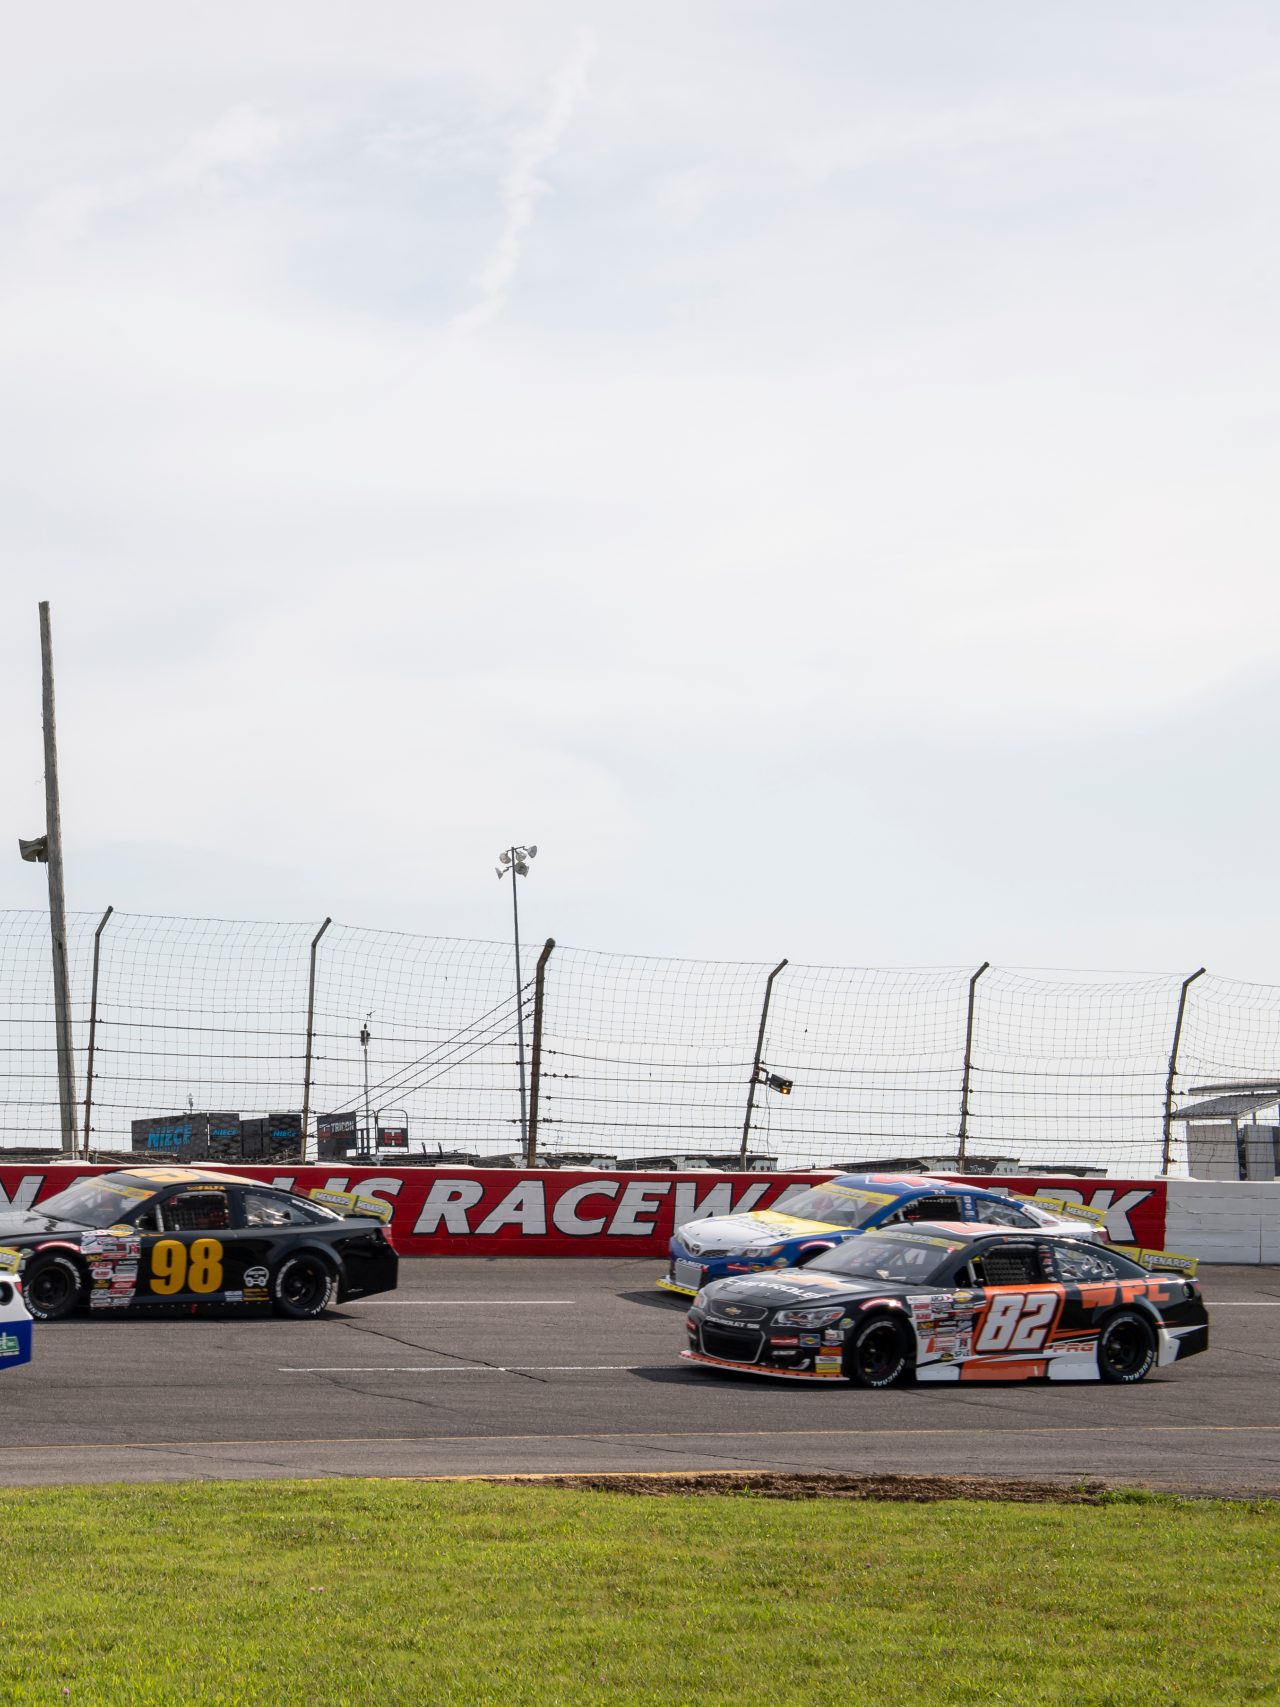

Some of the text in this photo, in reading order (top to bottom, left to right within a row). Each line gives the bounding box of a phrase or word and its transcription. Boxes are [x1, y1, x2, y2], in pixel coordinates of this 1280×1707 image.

[331, 1121, 355, 1132] TRICON
[150, 1238, 224, 1294] 98
[675, 1258, 710, 1269] CAMRY
[1144, 1253, 1193, 1269] MENARDS
[705, 1315, 745, 1328] CHEVROLET
[975, 1294, 1058, 1351] 82
[872, 1358, 905, 1387] GENERAL
[1122, 1350, 1153, 1381] GENERAL
